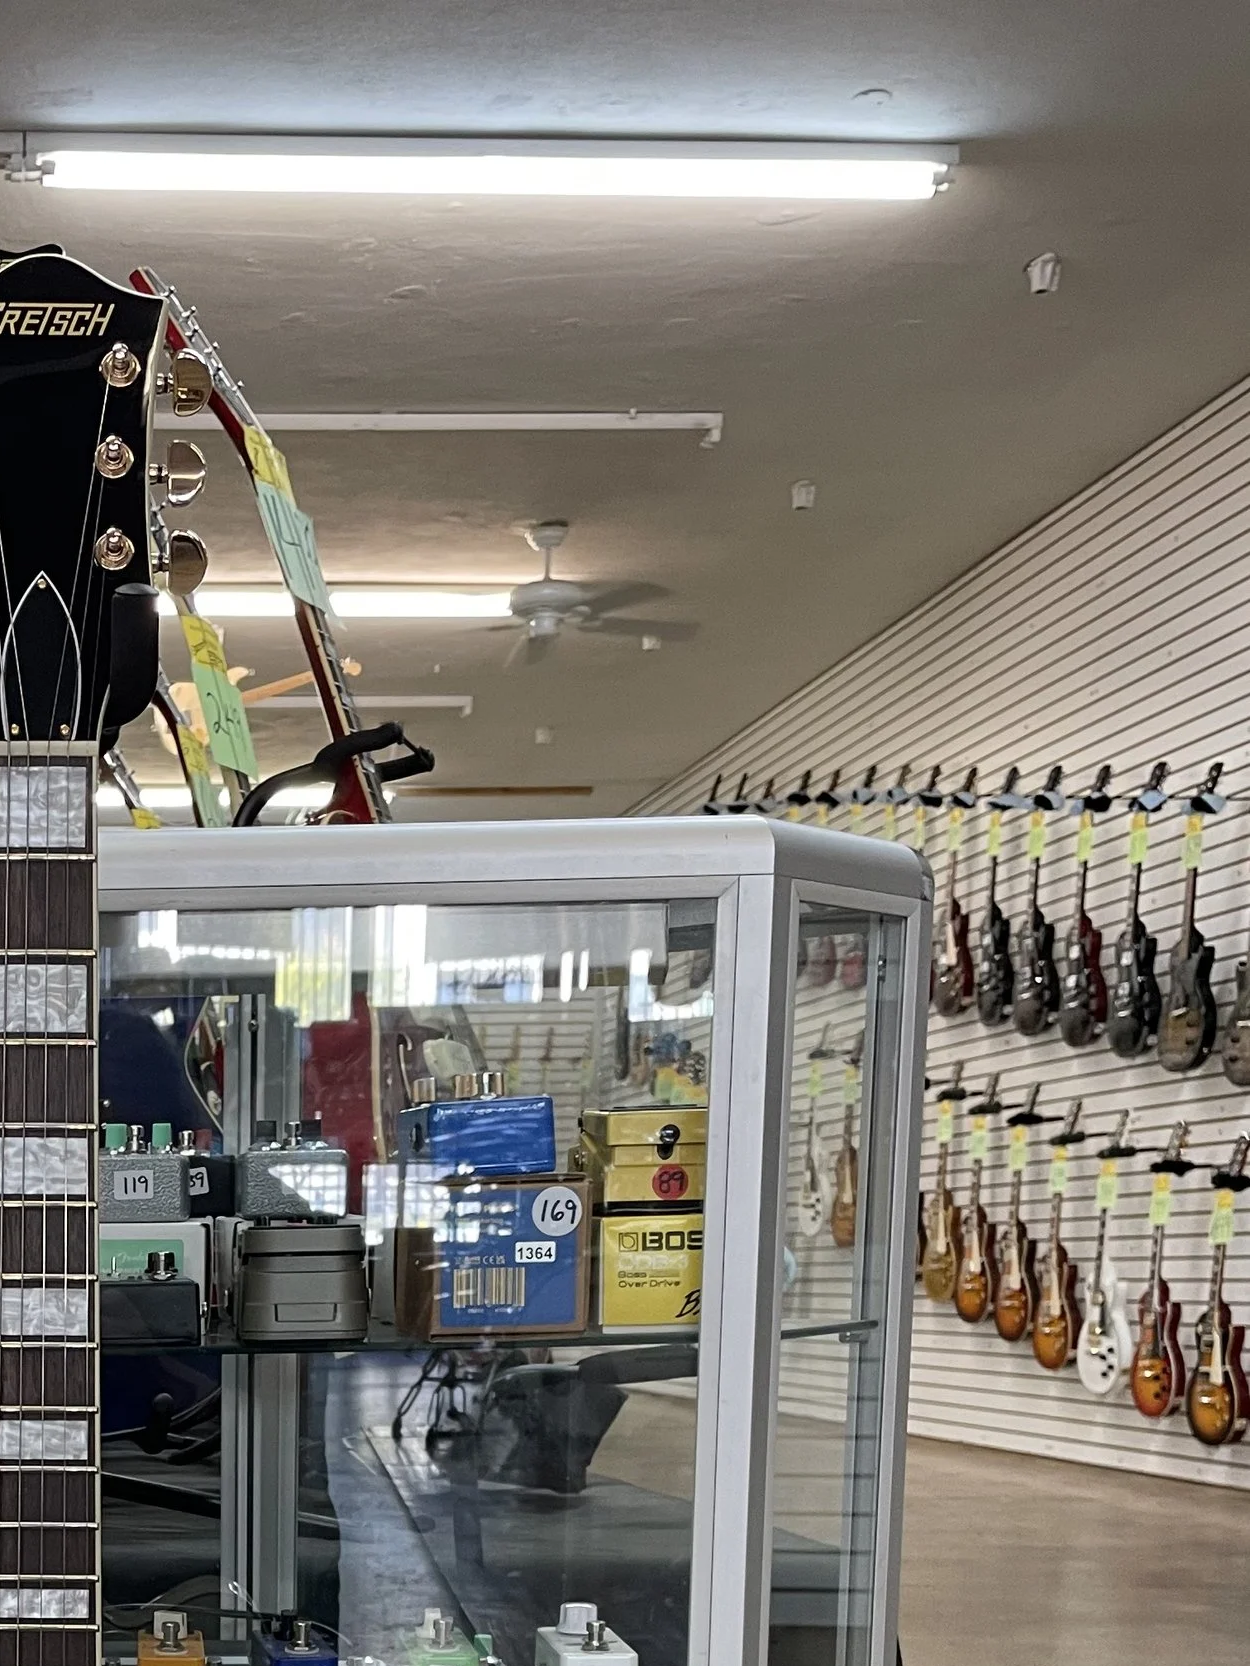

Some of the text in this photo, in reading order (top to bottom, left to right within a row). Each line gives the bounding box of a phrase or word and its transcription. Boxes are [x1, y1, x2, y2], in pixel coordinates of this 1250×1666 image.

[123, 1175, 149, 1195] 119
[658, 1170, 685, 1195] 89
[540, 1199, 578, 1225] 169
[641, 1230, 704, 1252] BOS
[517, 1245, 554, 1261] 1364
[618, 1279, 681, 1288] Over Drive
[675, 1288, 703, 1319] B
